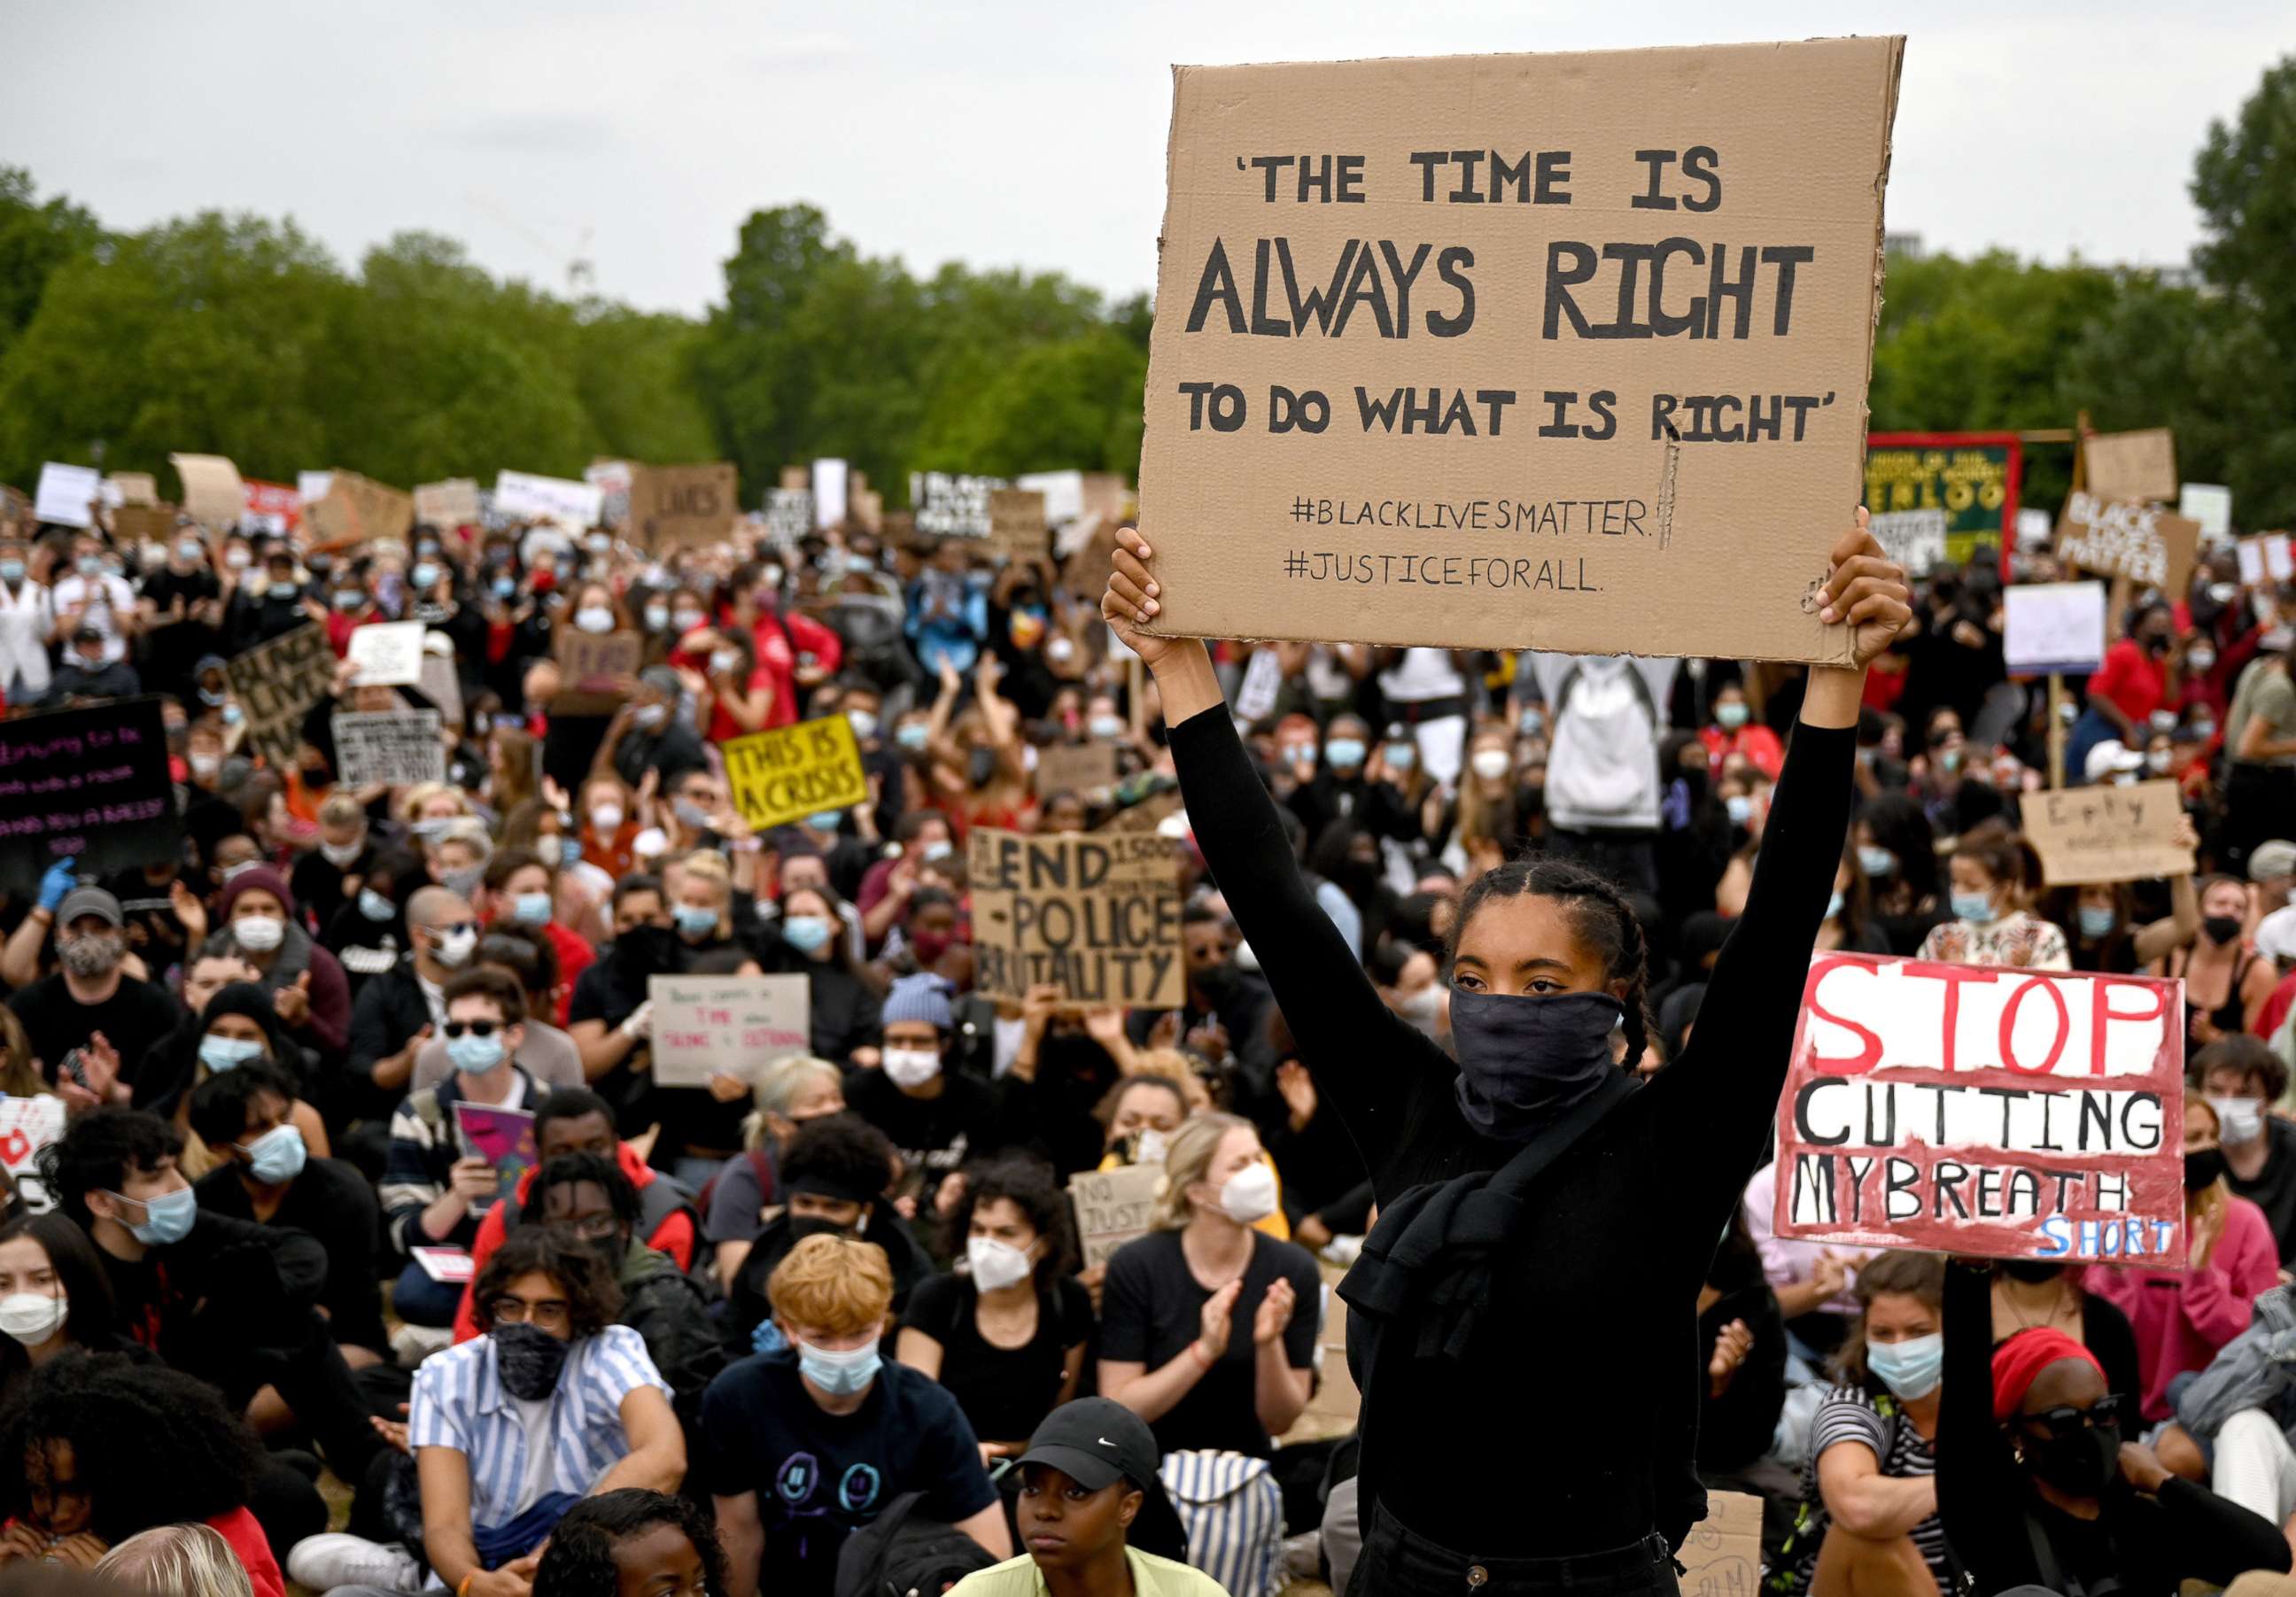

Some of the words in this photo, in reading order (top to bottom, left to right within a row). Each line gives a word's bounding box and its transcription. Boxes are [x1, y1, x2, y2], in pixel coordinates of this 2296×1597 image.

[1410, 151, 1571, 204] TIME
[1632, 146, 1720, 212] IS
[1185, 236, 1474, 337] ALWAYS
[1543, 237, 1813, 339] RIGHT
[1179, 382, 1245, 432] TO
[1269, 386, 1330, 433] DO
[1354, 386, 1515, 435] WHAT
[1540, 391, 1617, 440] IS
[735, 732, 804, 776] THIS
[809, 726, 840, 758] IS
[742, 787, 766, 819] A
[764, 758, 858, 815] CRISIS
[1000, 839, 1112, 890] END
[1011, 894, 1180, 950] POLICE
[1804, 959, 2167, 1075] STOP
[1794, 1077, 2162, 1151] CUTTING
[1080, 1178, 1113, 1205] NO
[2036, 1216, 2175, 1257] SHORT
